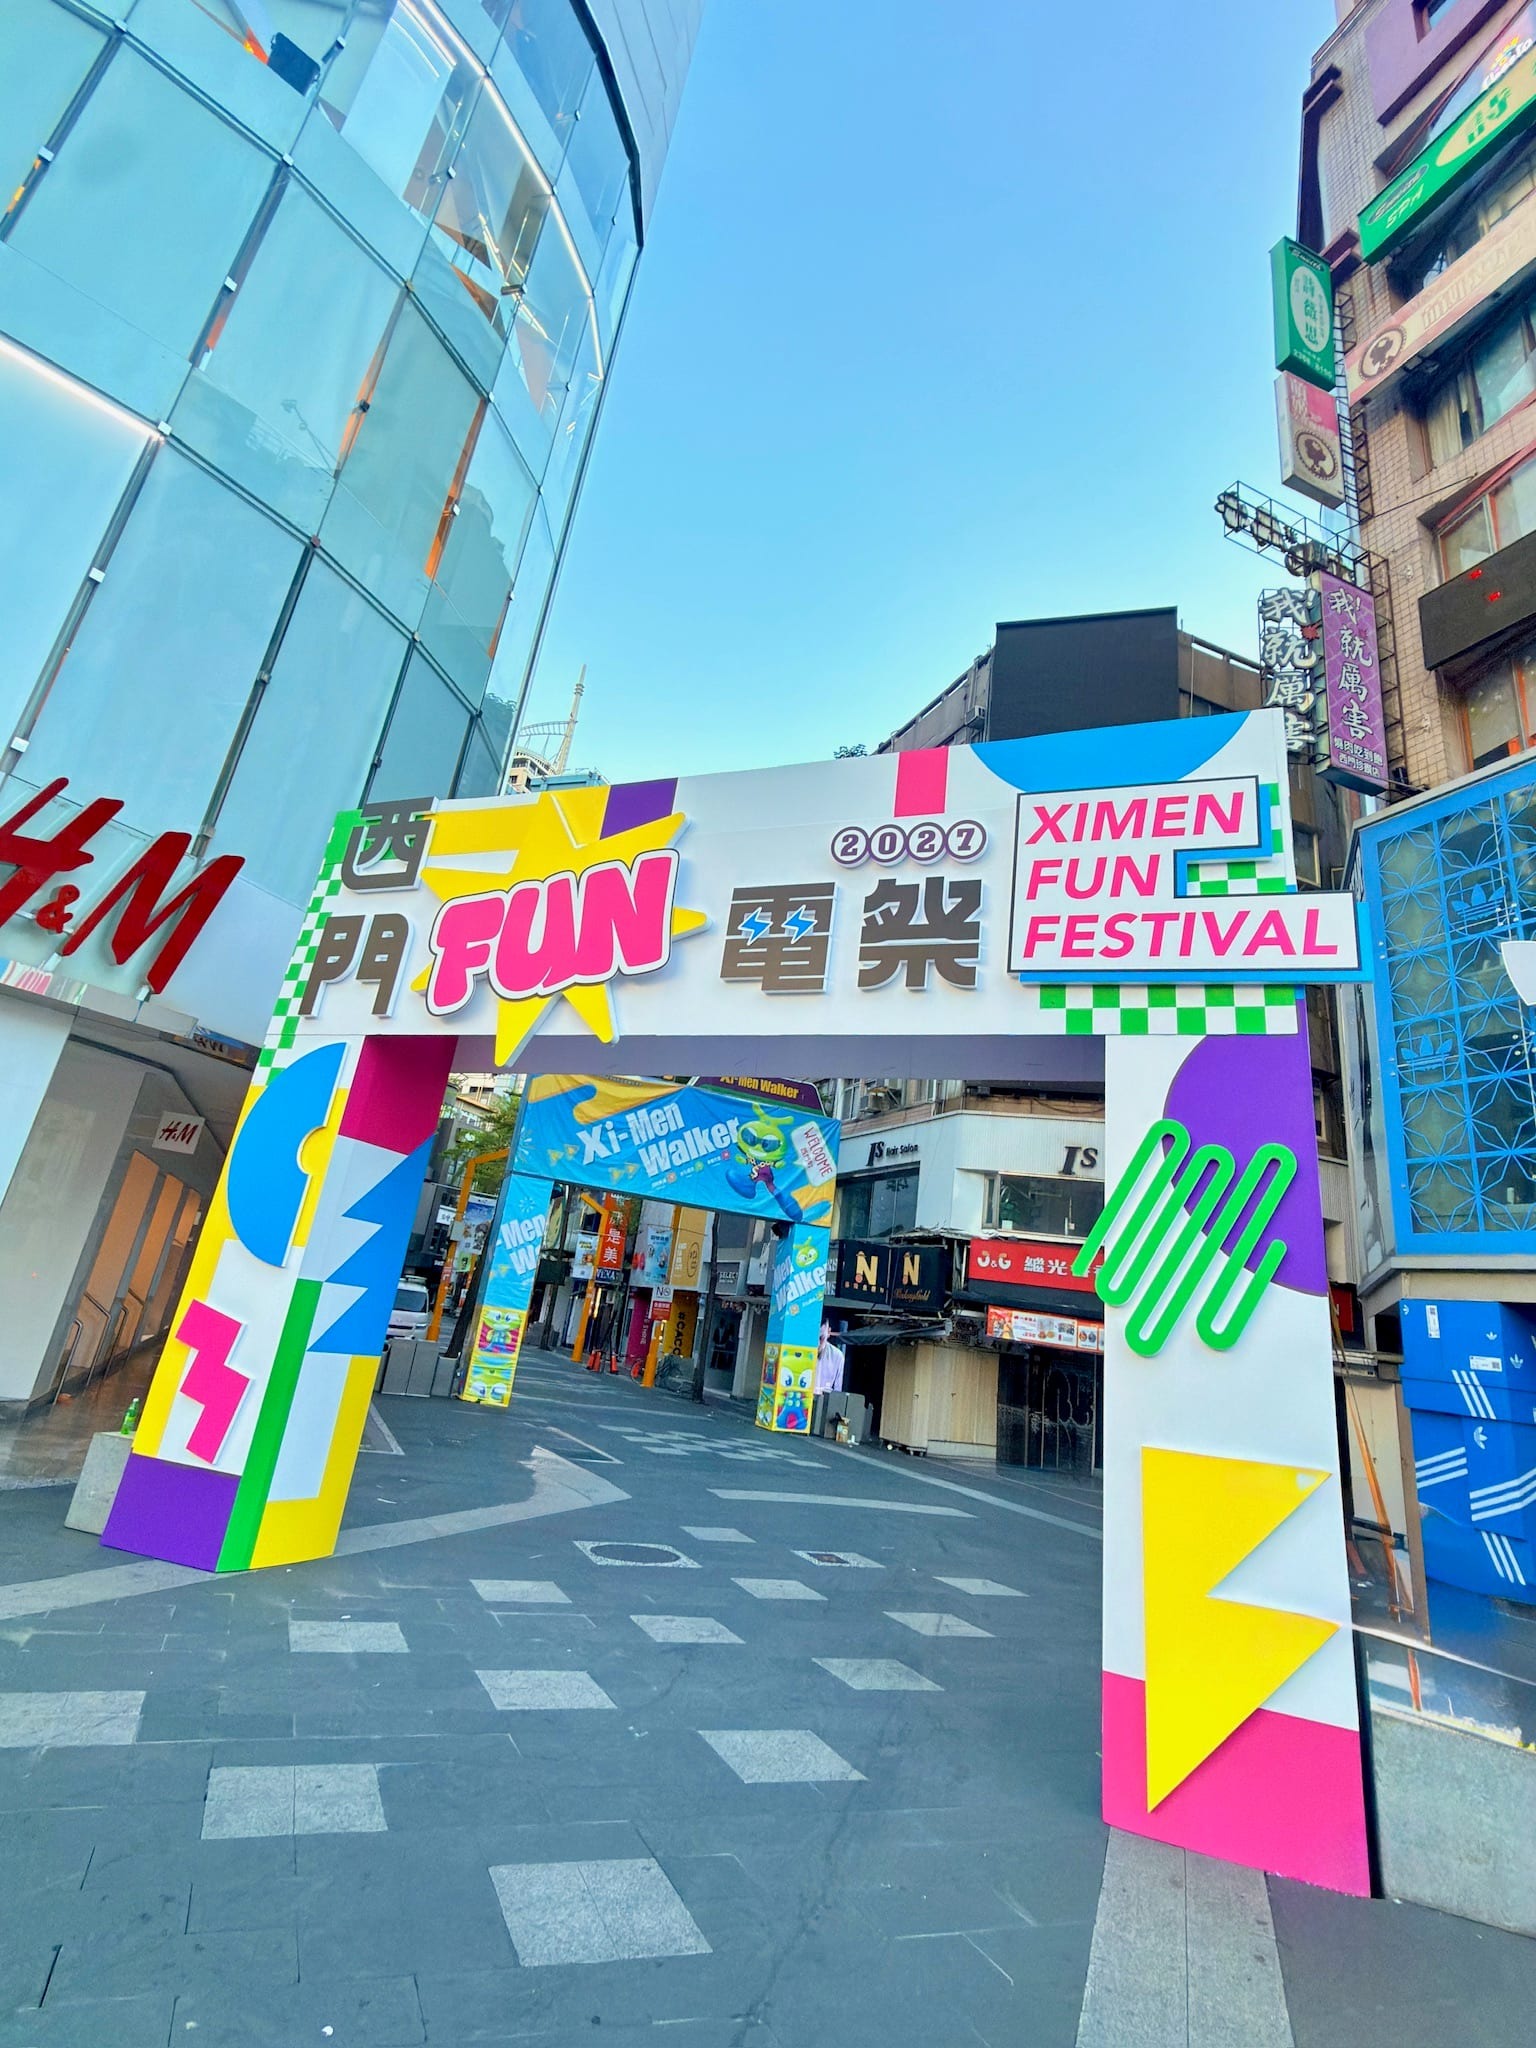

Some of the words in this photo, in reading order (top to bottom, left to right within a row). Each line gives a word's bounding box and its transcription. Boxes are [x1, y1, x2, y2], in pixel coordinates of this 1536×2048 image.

[1025, 791, 1245, 846] XIMEN
[835, 823, 982, 866] 2027
[0, 777, 246, 994] H&M
[1026, 854, 1161, 900] FUN
[300, 796, 437, 1017] 西門
[431, 853, 676, 1010] FUN
[1022, 908, 1339, 958] FESTIVAL
[760, 1079, 799, 1099] Walker
[158, 1120, 199, 1145] H&M
[577, 1103, 686, 1166] Xi-Men
[638, 1116, 740, 1177] Walker
[803, 1126, 833, 1177] WELCOME
[899, 1144, 919, 1154] Salon
[977, 1250, 1011, 1269] J&G
